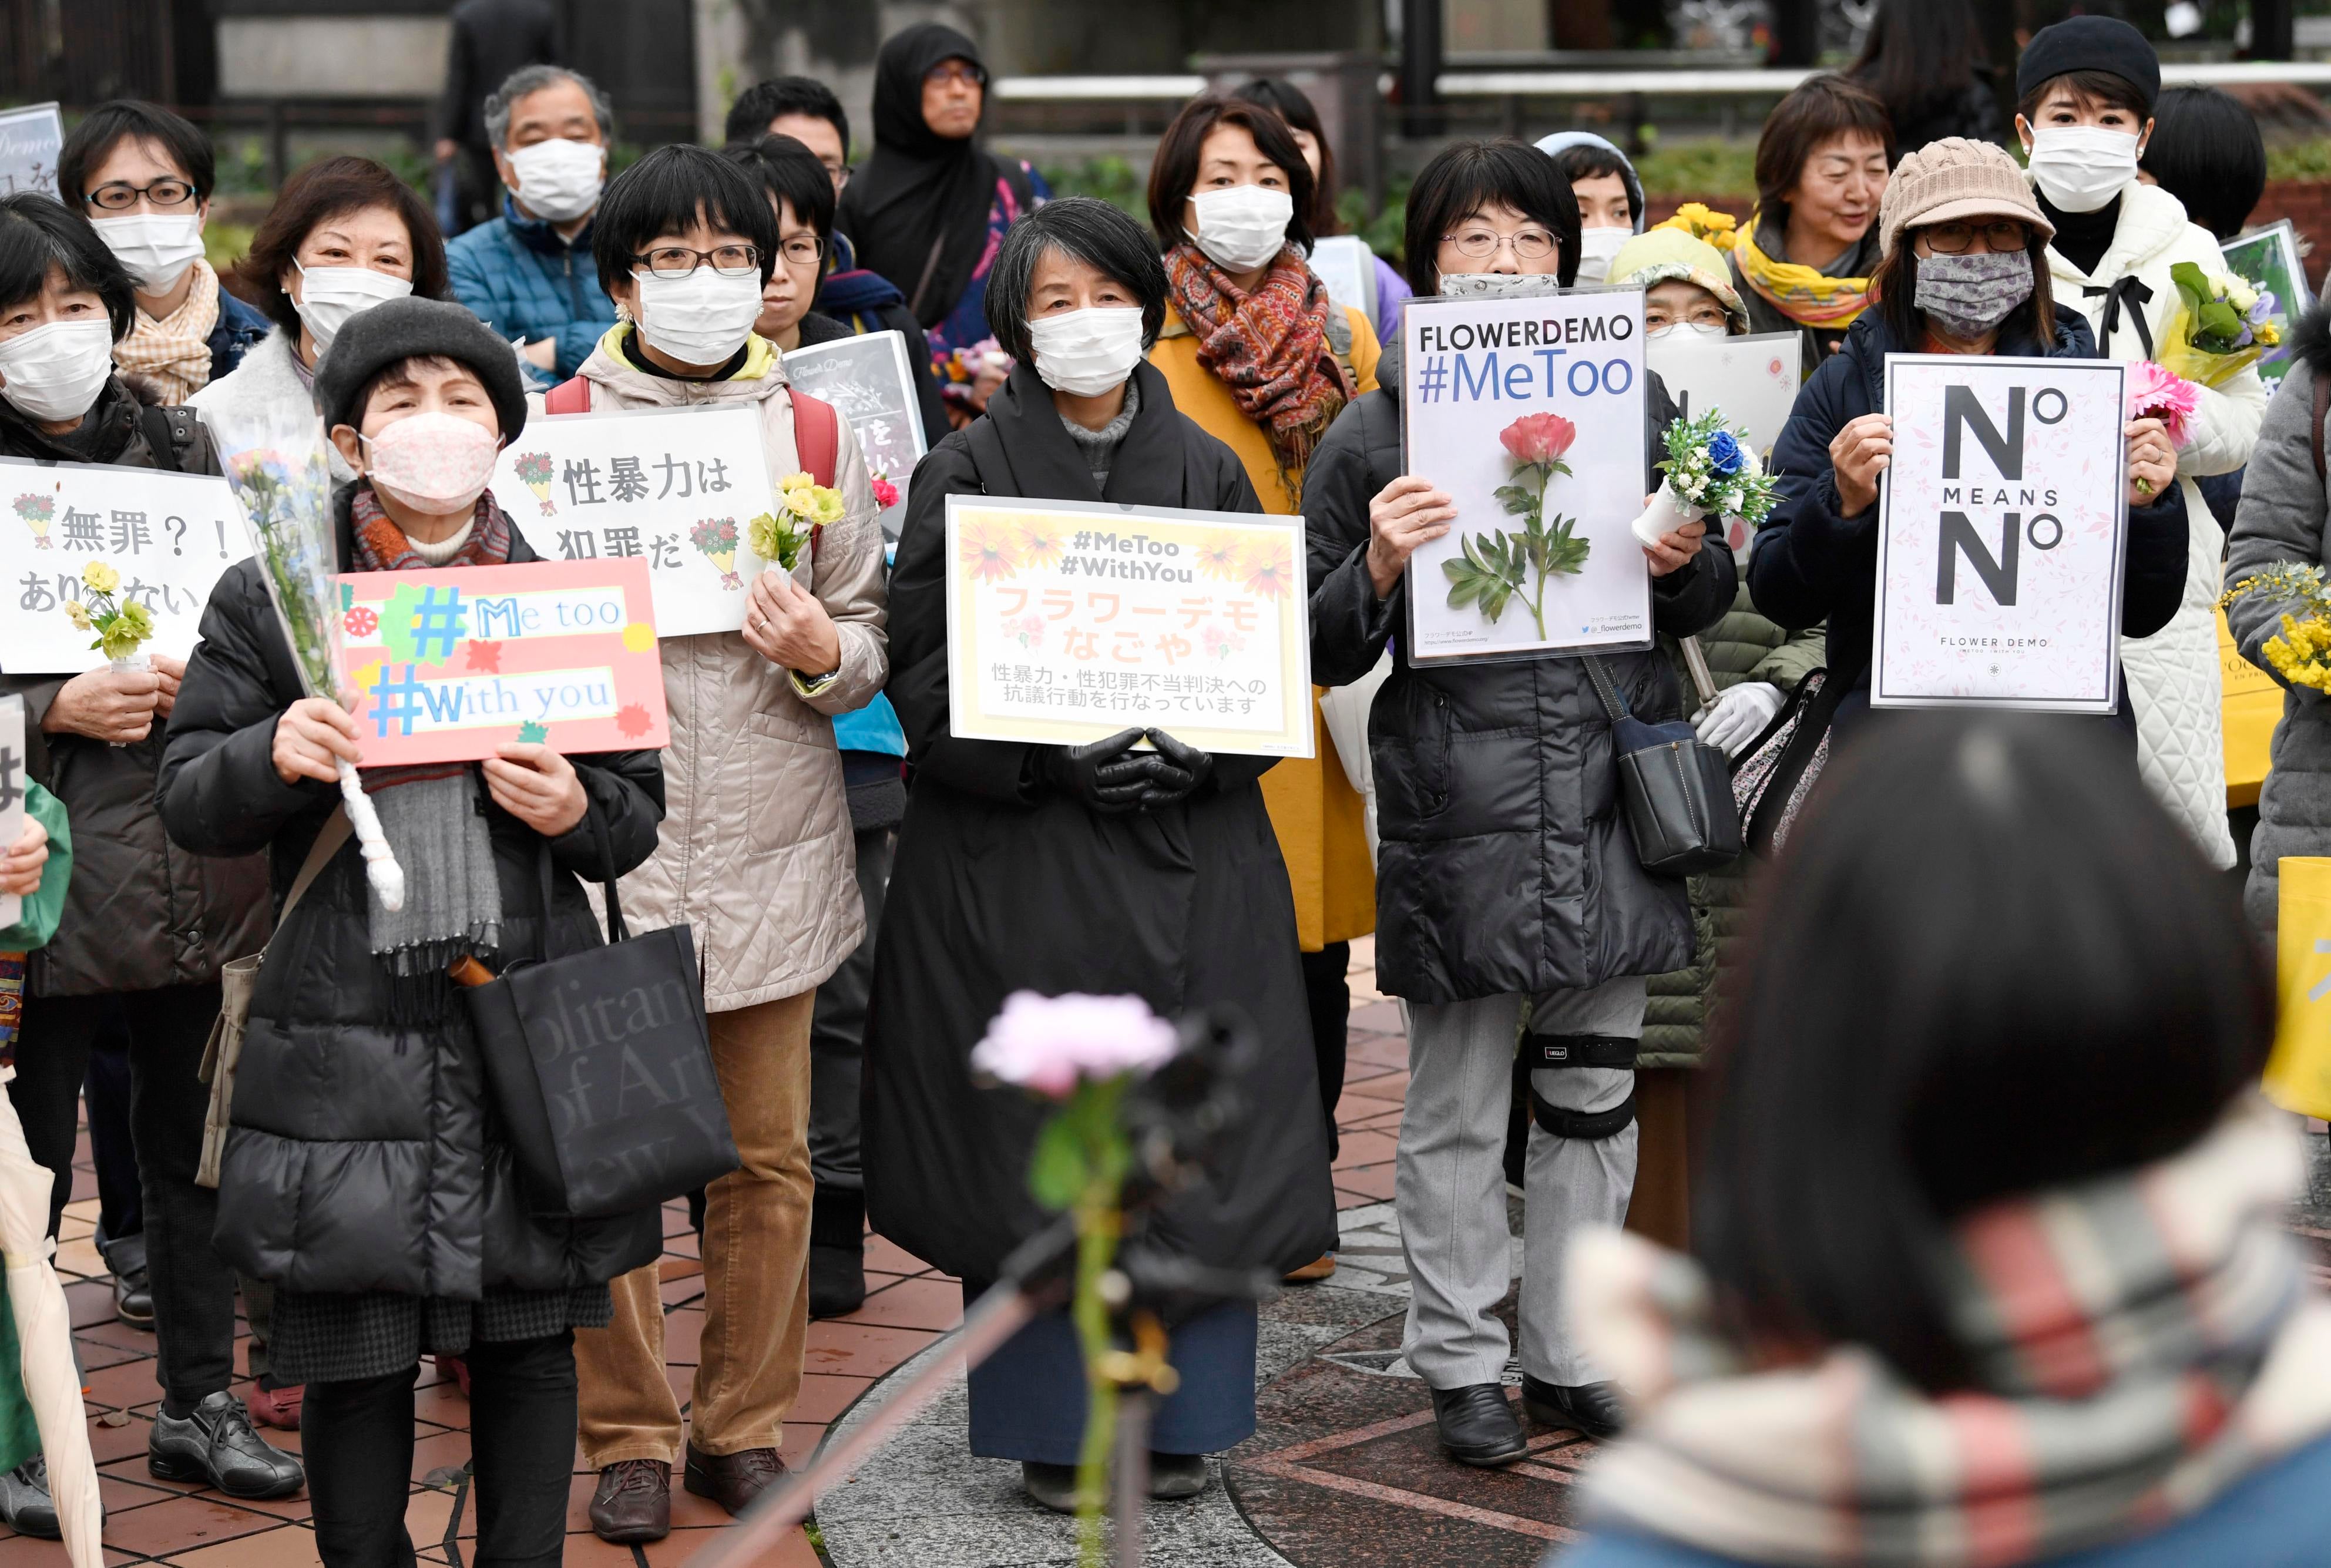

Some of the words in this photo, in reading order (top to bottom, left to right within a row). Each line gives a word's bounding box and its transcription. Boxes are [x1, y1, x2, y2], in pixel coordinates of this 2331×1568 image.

[1420, 314, 1633, 352] FLOWERDEMO
[1418, 348, 1633, 404] #MeToo
[563, 453, 733, 506] 性暴力は
[1943, 488, 2057, 506] MEANS
[61, 505, 229, 559] 無罪？！
[556, 526, 683, 570] 犯罪だ
[1073, 530, 1180, 556] #MeToo
[1060, 556, 1193, 583] #WithYou
[555, 599, 620, 628] too
[996, 587, 1258, 632] フラワーデモ
[1064, 626, 1191, 666] なごや
[1591, 623, 1642, 634] @_flowerdemo
[1940, 637, 1997, 646] FLOWER
[2007, 639, 2047, 647] DEMO
[992, 663, 1267, 696] 性暴力・性犯罪不当判決への
[534, 680, 609, 719] you
[1004, 683, 1257, 715] 抗議行動を行なっています
